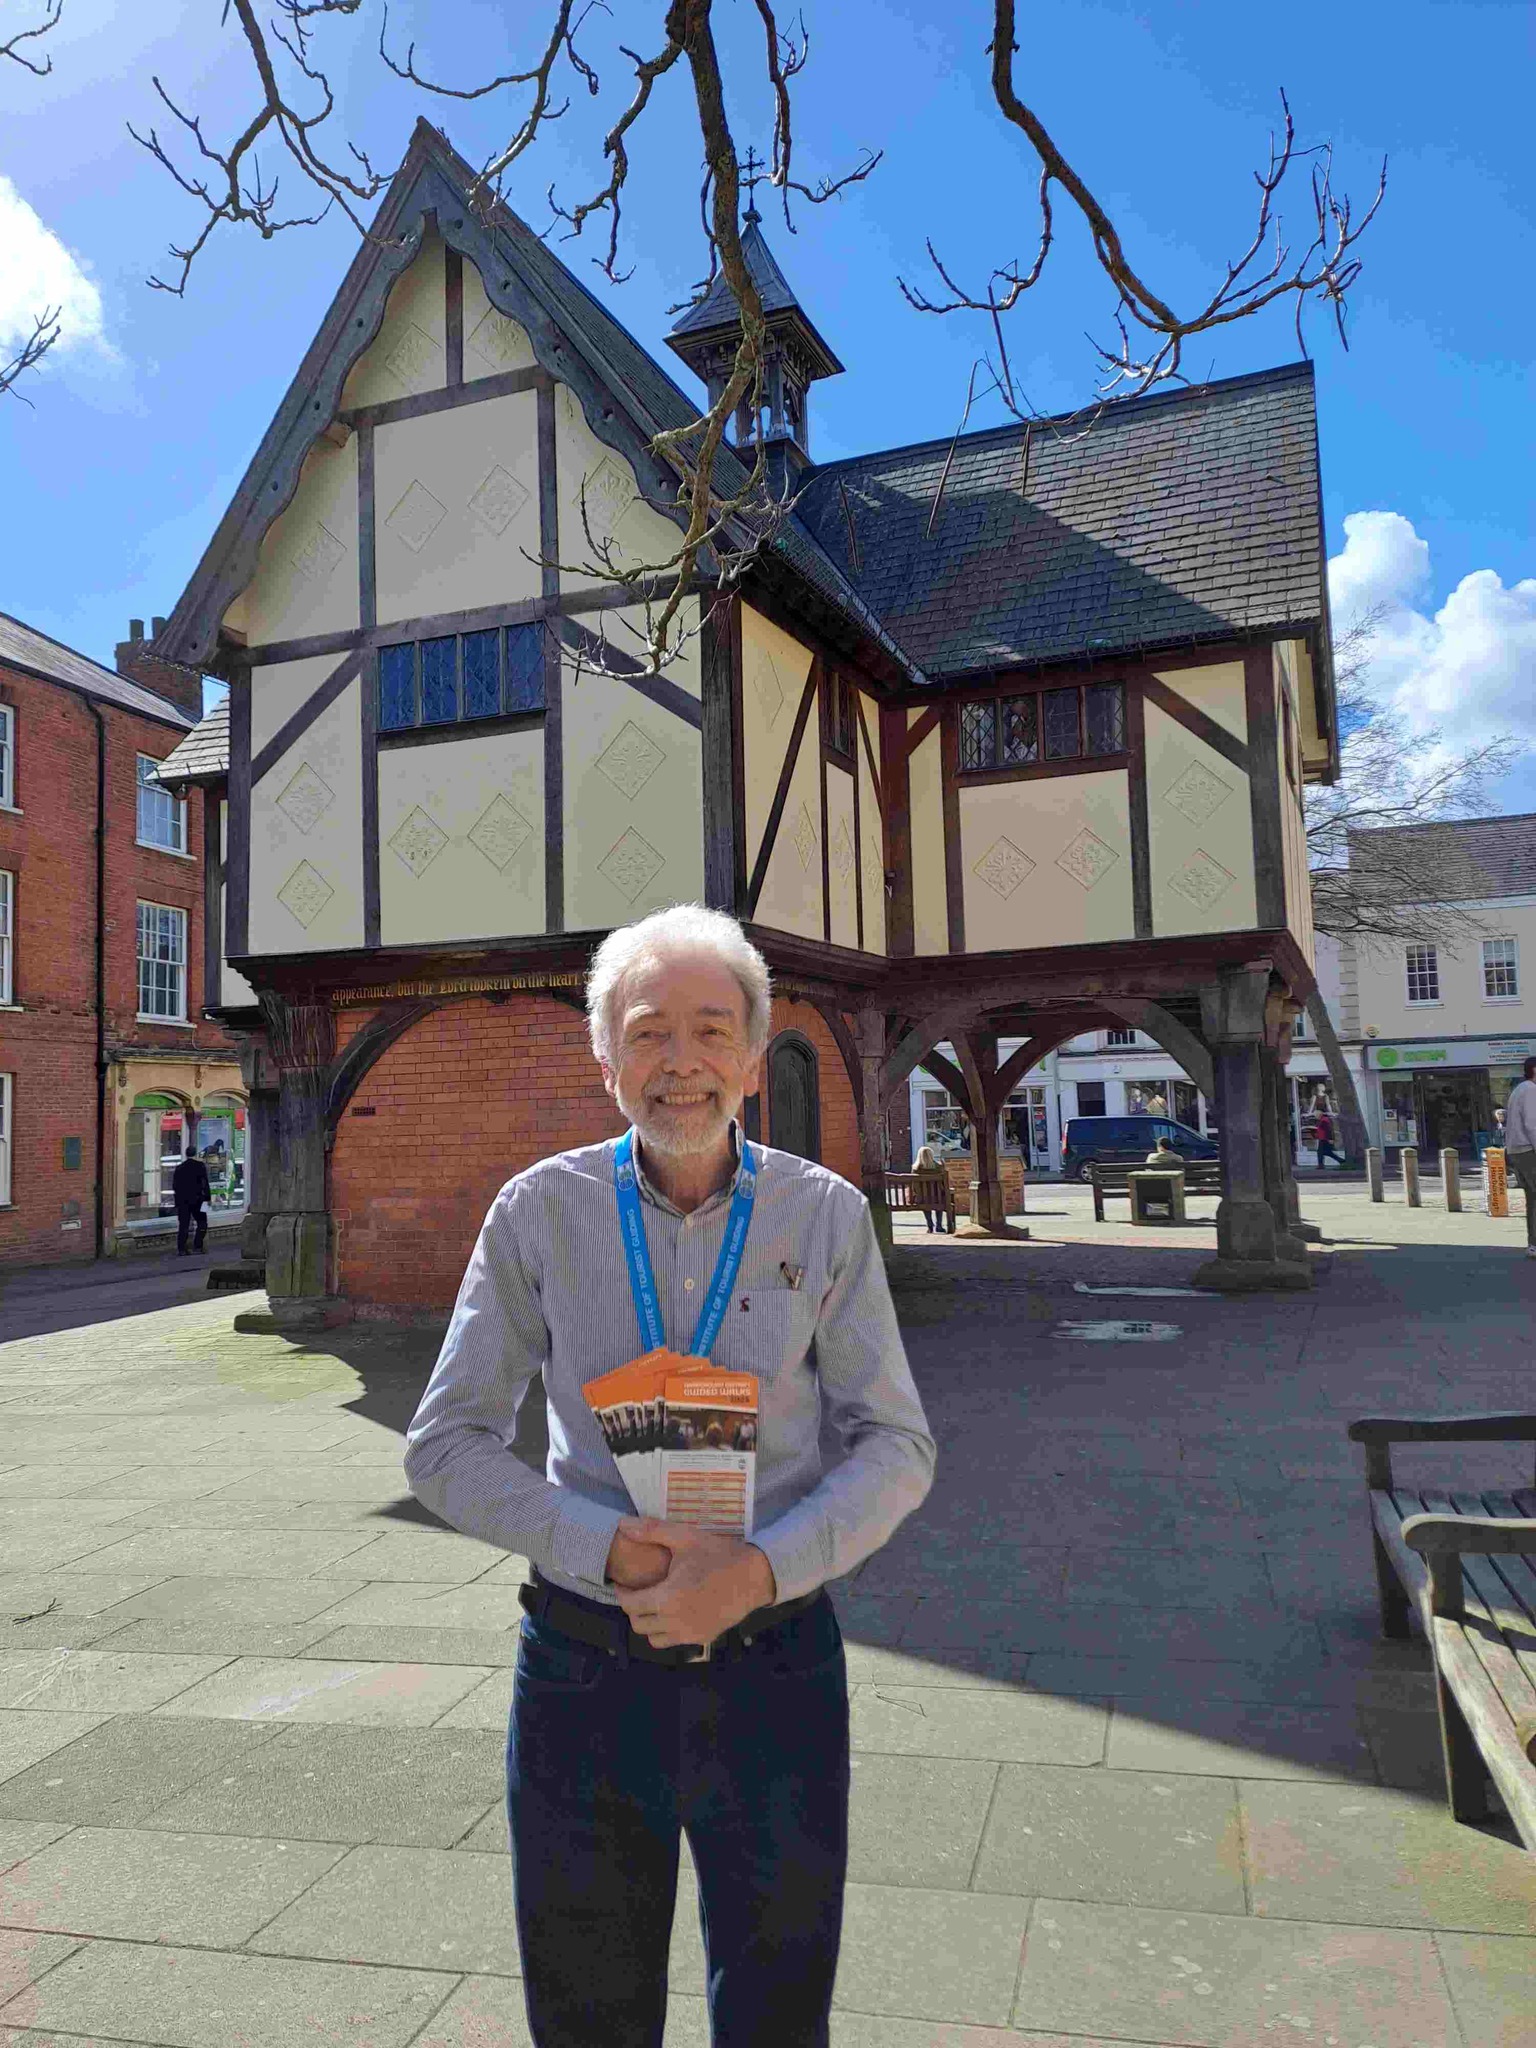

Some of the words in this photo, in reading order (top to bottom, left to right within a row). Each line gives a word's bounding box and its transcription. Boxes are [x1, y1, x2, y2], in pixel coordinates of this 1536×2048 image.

[397, 979, 414, 997] but
[418, 978, 432, 995] the
[512, 976, 526, 989] on
[527, 971, 546, 988] the
[627, 1208, 640, 1247] GUIDING
[634, 1249, 648, 1289] TOURIST
[642, 1292, 651, 1305] OF
[713, 1296, 722, 1310] OF
